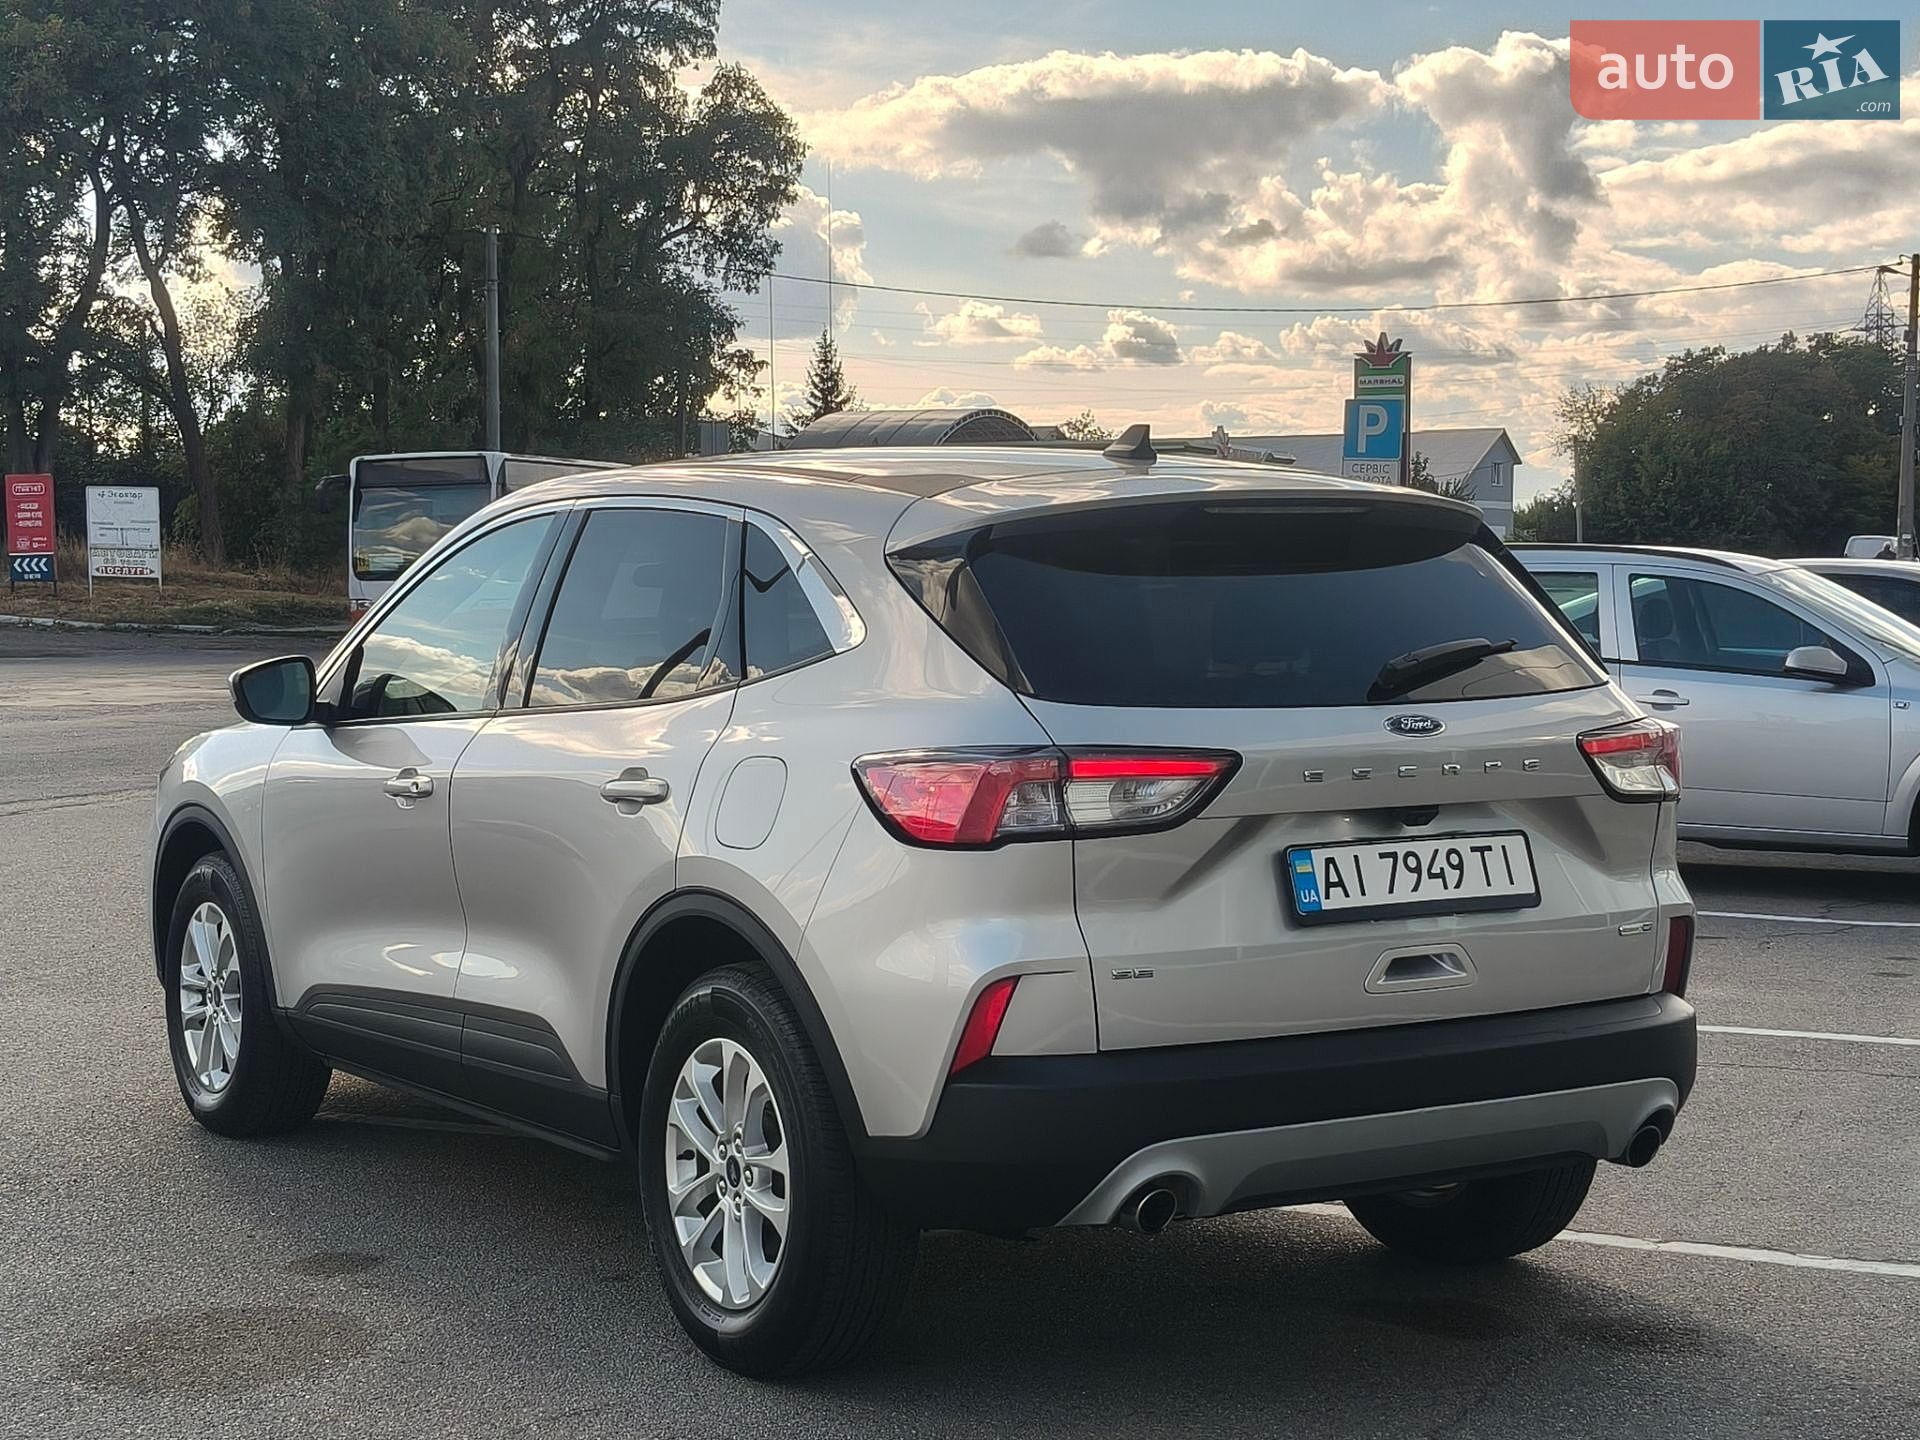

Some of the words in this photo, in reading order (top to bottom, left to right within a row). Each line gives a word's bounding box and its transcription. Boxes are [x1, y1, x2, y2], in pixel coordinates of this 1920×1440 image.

[1357, 404, 1388, 453] P
[99, 566, 151, 575] ПОСЛУГИ
[1400, 716, 1434, 730] Ford
[1303, 759, 1540, 783] ESCAPE
[1324, 855, 1367, 900] AI
[1378, 847, 1466, 894] 7949
[1469, 845, 1515, 888] TI
[1300, 889, 1319, 903] UA
